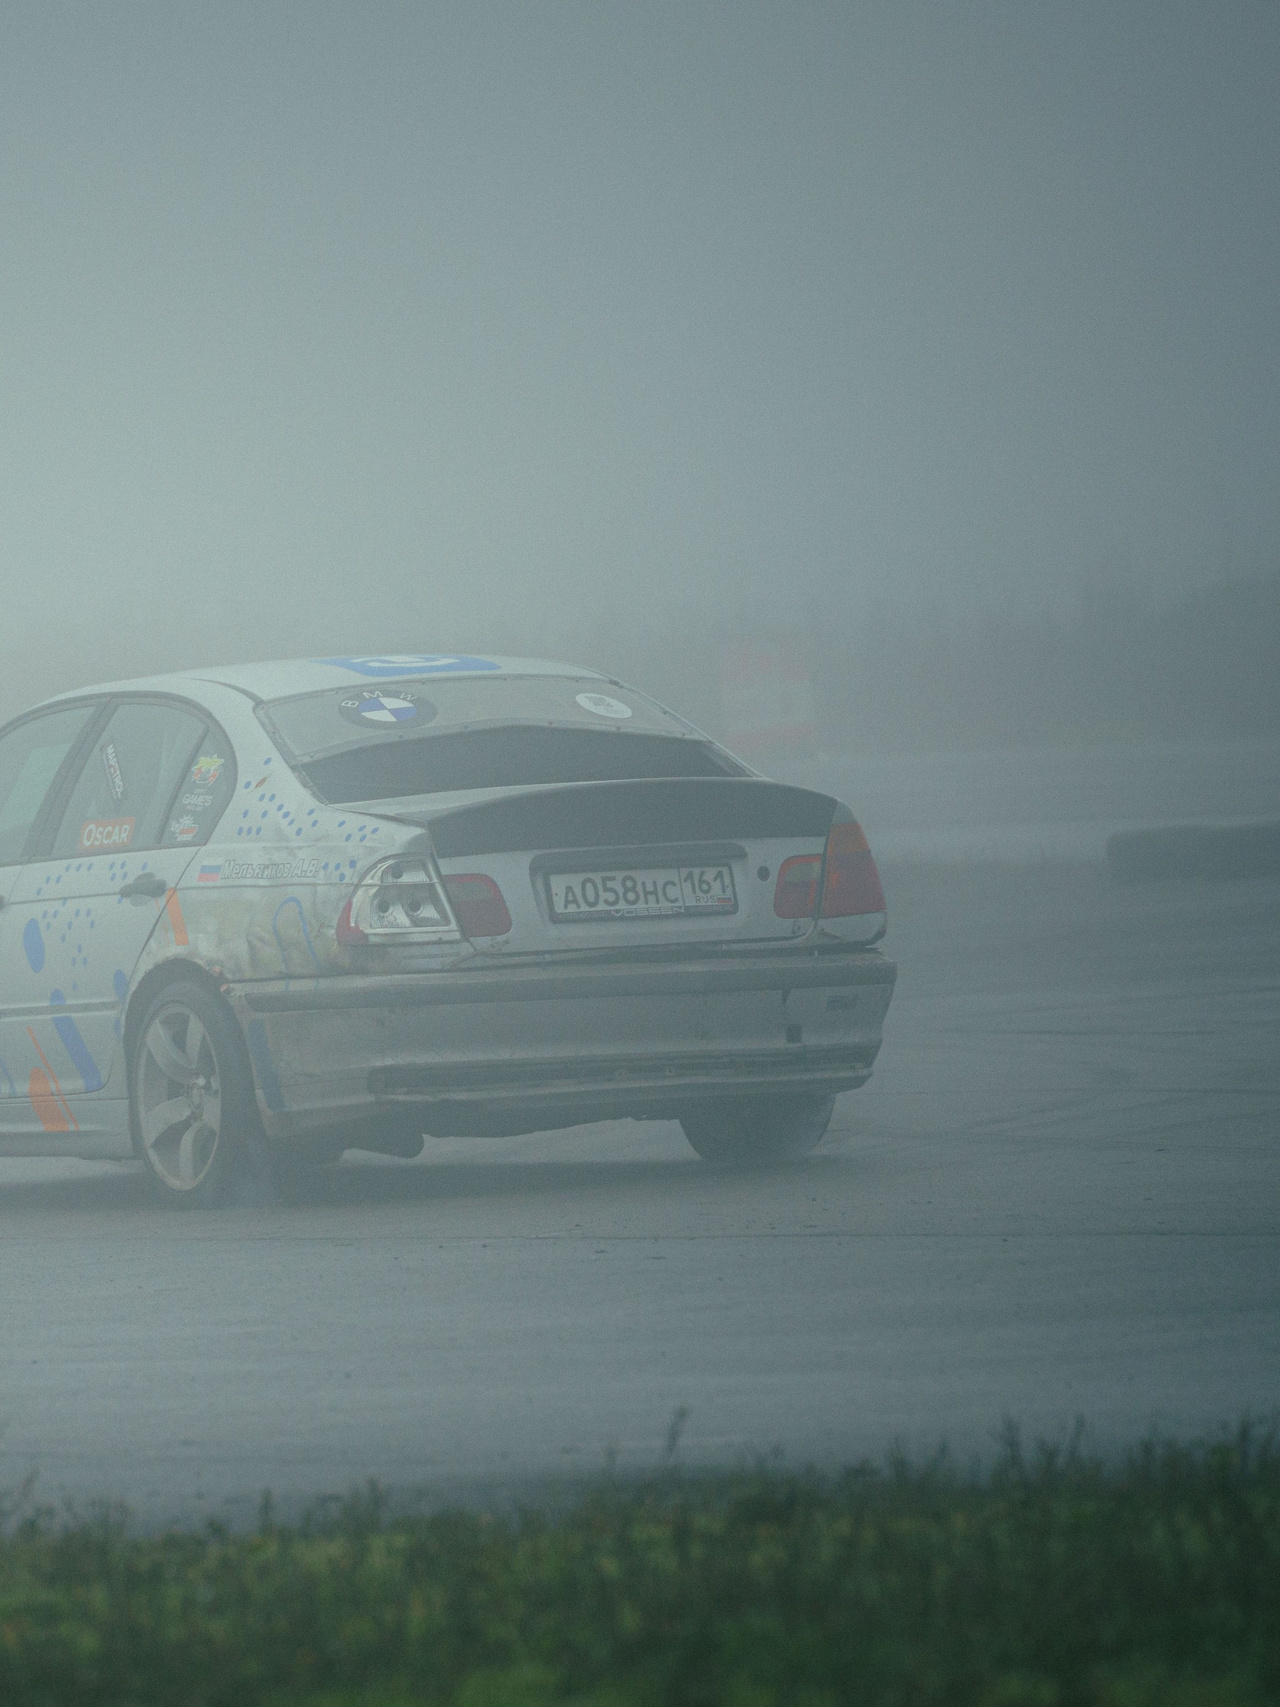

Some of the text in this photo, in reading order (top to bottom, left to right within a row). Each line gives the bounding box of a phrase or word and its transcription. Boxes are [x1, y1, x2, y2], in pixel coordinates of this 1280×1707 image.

[341, 690, 418, 708] BMW
[683, 870, 727, 895] 161
[695, 895, 716, 905] RUS
[611, 906, 684, 917] VOSSEN
